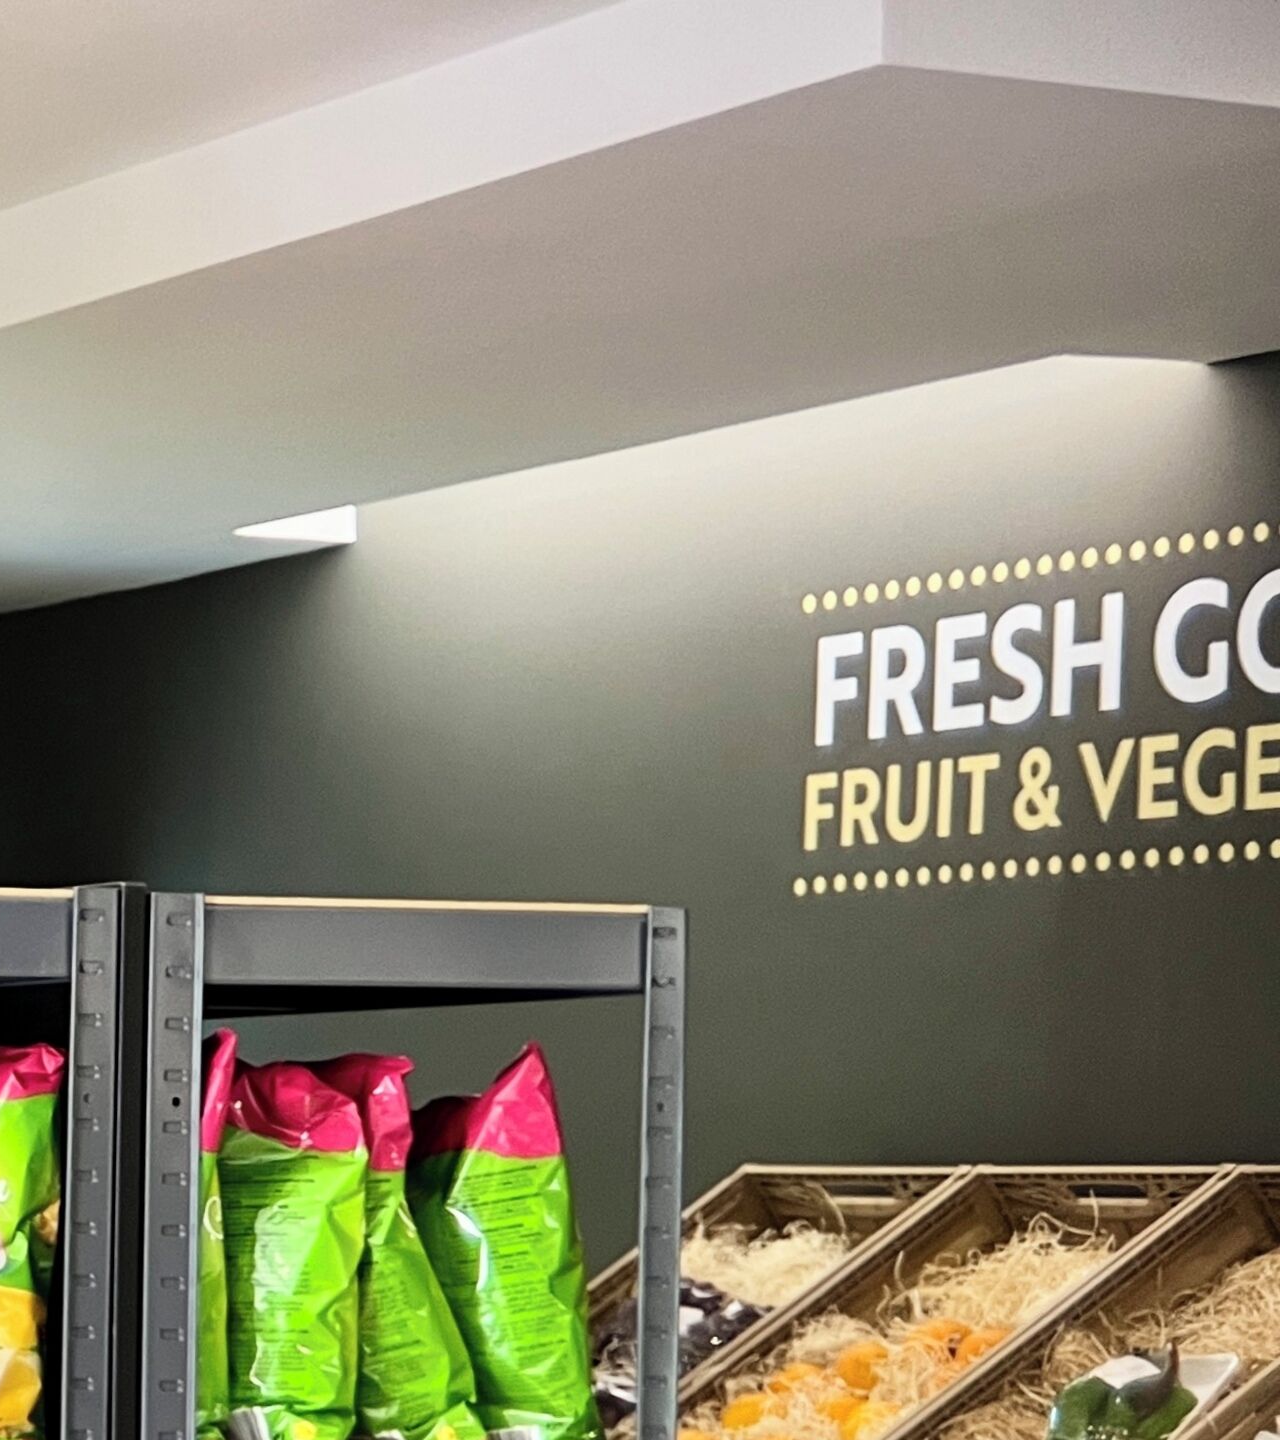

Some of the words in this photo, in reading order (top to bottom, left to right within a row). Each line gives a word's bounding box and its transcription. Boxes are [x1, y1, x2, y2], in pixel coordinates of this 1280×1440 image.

[814, 591, 1125, 747] FRESH
[803, 752, 1001, 852] FRUIT
[1013, 746, 1062, 831] &
[1078, 723, 1280, 822] VEGE
